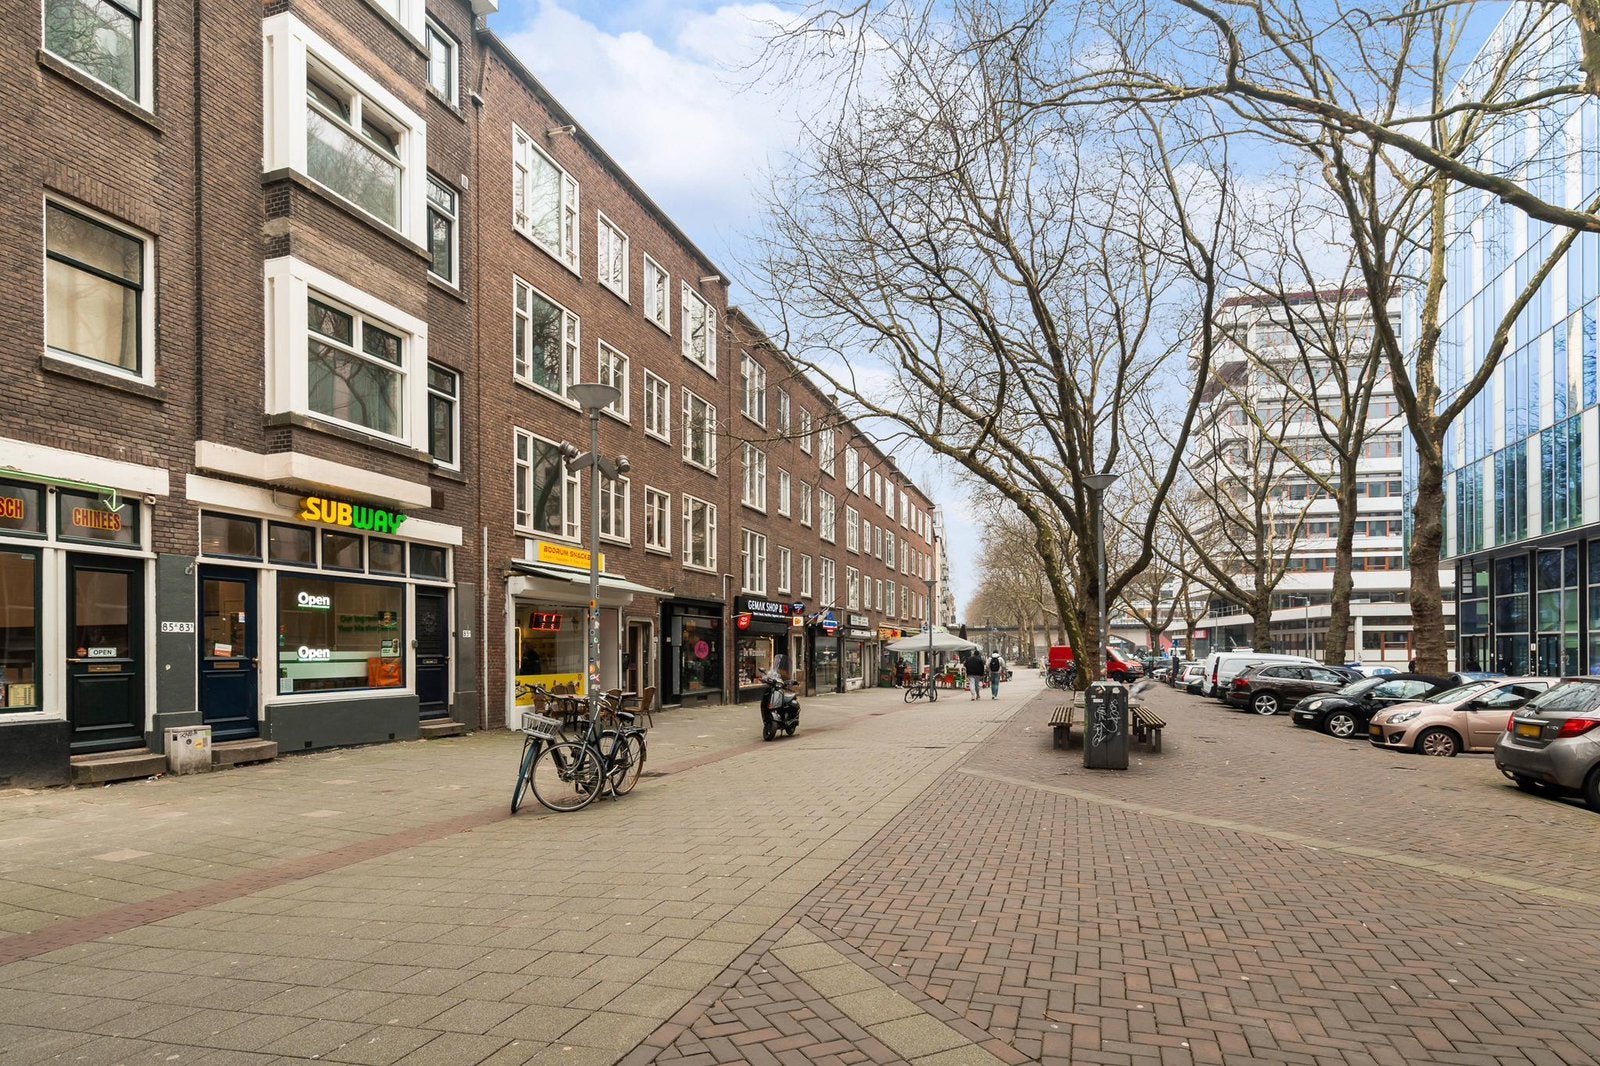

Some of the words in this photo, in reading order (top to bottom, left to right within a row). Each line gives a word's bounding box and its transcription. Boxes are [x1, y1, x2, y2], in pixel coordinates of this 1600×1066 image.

[72, 507, 121, 531] CHINEES
[301, 497, 407, 535] SUBWAY
[543, 545, 568, 556] BODRUM
[298, 592, 330, 608] Open
[747, 600, 766, 611] GEMAK
[766, 602, 779, 613] SHOP
[298, 645, 330, 660] Open
